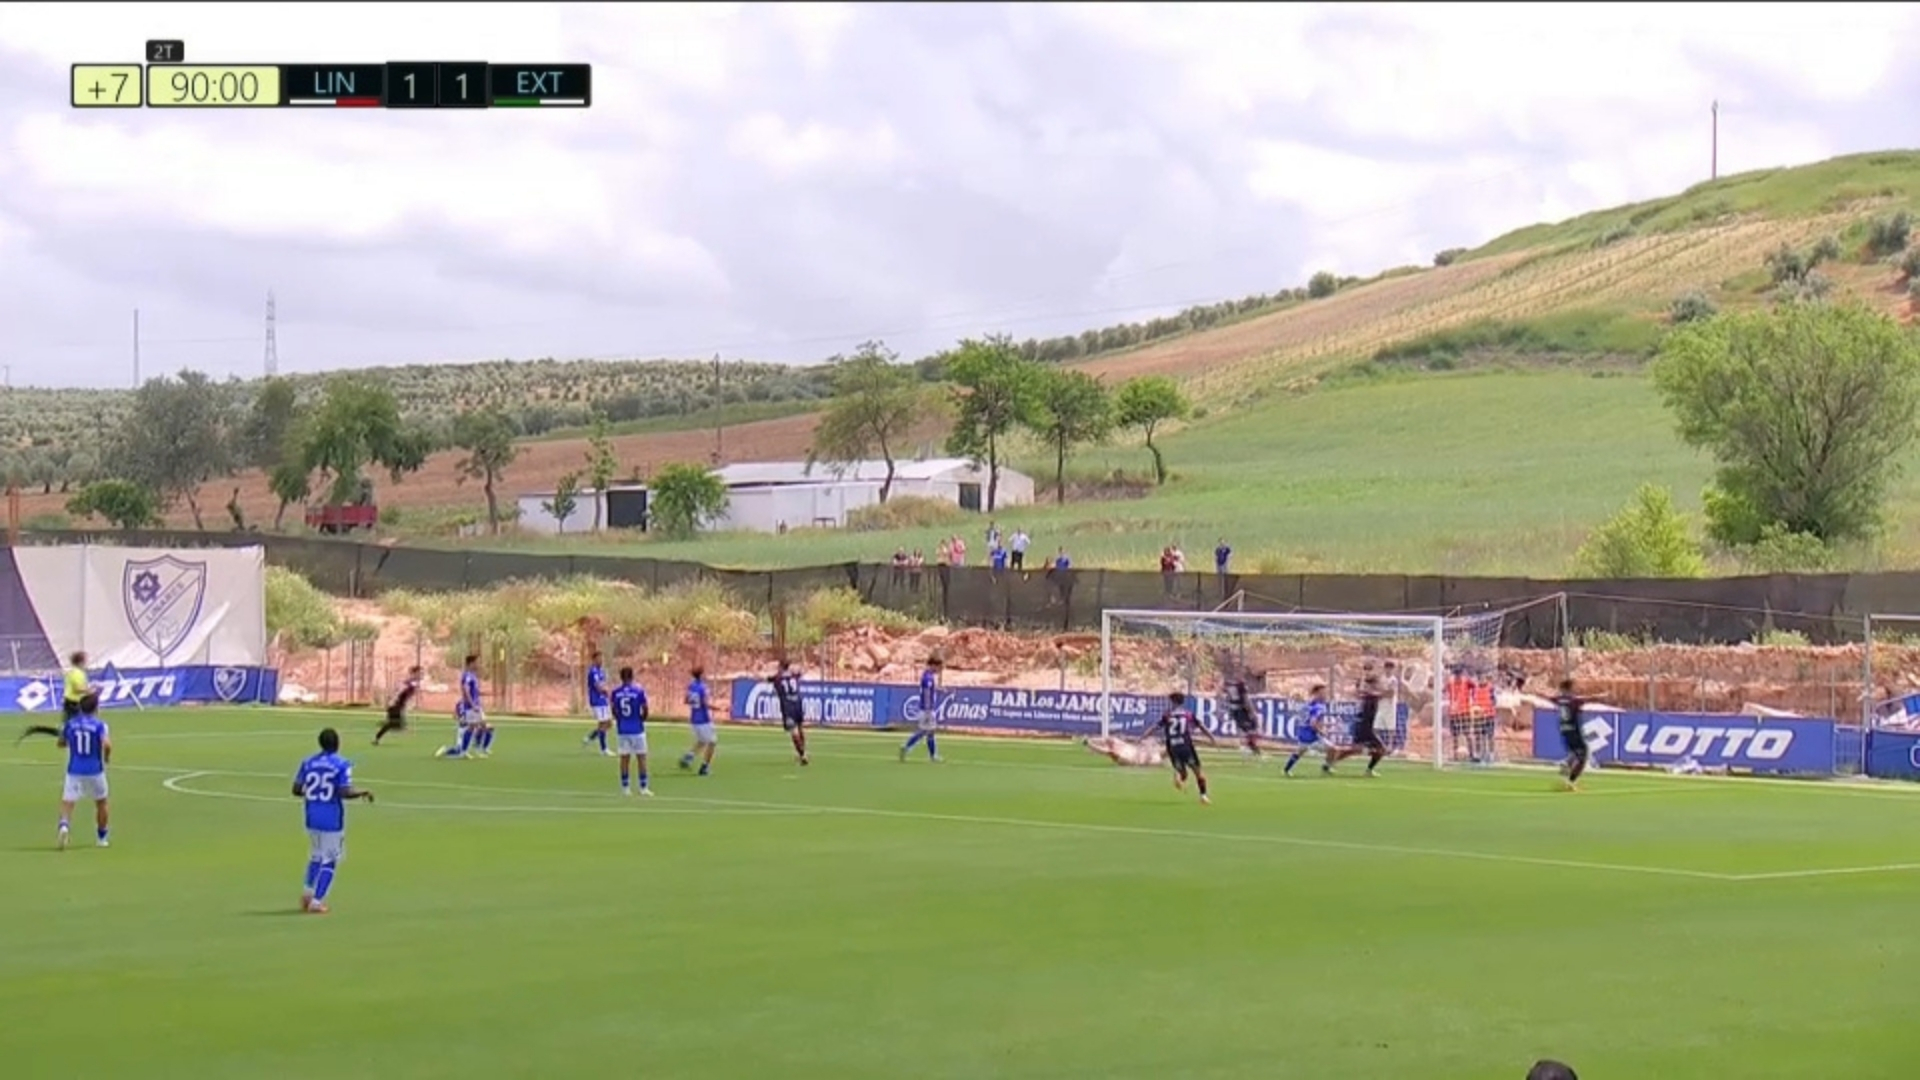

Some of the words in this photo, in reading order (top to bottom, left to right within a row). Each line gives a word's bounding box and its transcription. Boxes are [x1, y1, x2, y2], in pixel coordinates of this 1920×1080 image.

[88, 675, 176, 703] OTTO
[990, 690, 1028, 708] BAR
[619, 697, 631, 717] 5
[1194, 697, 1297, 740] Baili
[1168, 717, 1187, 736] 21
[74, 729, 92, 755] 11
[1624, 723, 1794, 760] LOTTO
[305, 771, 335, 802] 25
